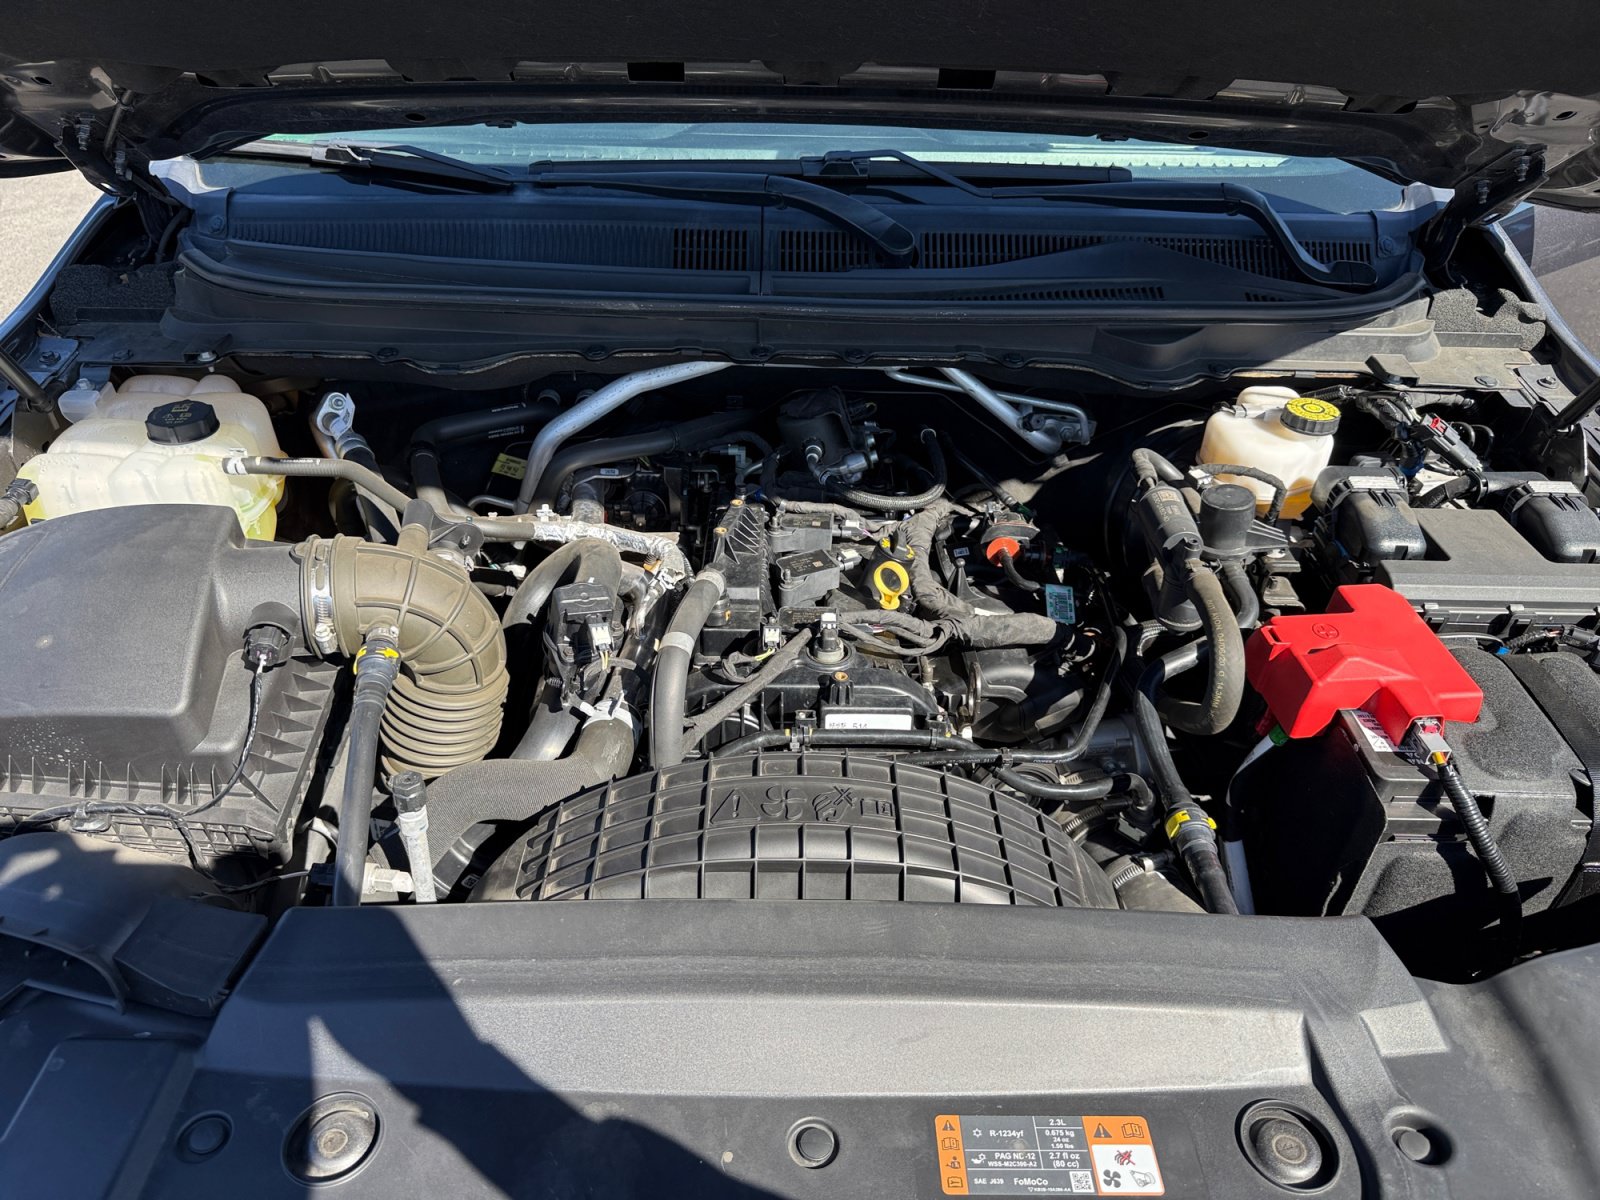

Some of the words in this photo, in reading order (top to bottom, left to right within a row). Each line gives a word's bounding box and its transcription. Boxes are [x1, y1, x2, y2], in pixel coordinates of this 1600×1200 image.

[1049, 1118, 1067, 1126] 2.3L
[989, 1129, 1024, 1138] R-1234yf
[1065, 1129, 1075, 1138] kg
[994, 1152, 1012, 1160] PAG
[1049, 1152, 1061, 1160] 2.7
[1062, 1152, 1069, 1160] fl
[1052, 1160, 1066, 1169] (80
[1066, 1160, 1080, 1169] cc)
[974, 1177, 987, 1185] SAE
[1013, 1177, 1049, 1186] FoMoCo
